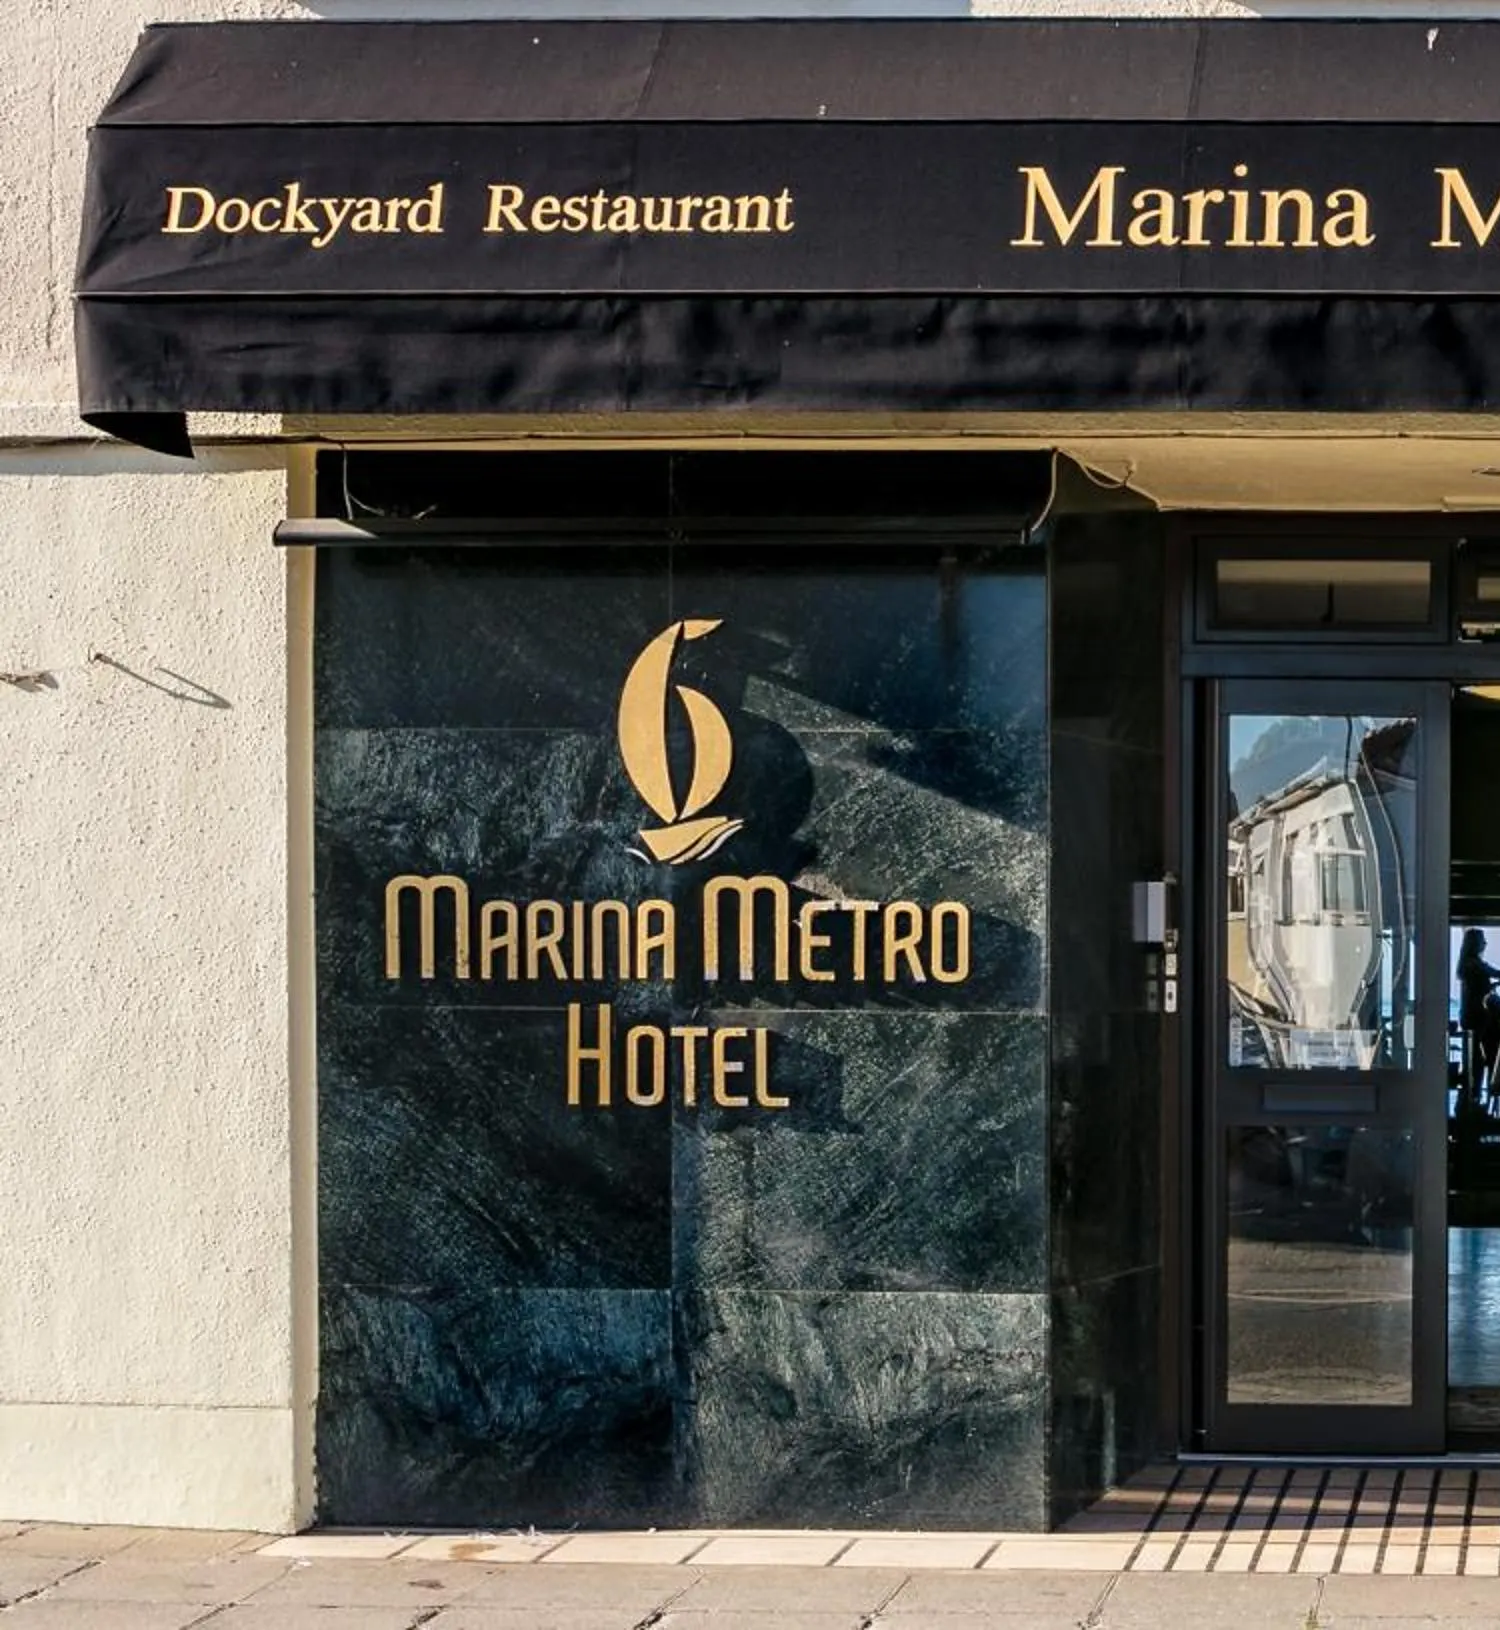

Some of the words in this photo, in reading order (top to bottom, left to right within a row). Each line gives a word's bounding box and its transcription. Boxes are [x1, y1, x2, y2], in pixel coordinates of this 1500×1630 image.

[162, 182, 444, 248] Dockyard
[483, 184, 793, 233] Restaurant
[1010, 164, 1375, 248] Marina
[385, 874, 676, 981] MARINA
[702, 875, 971, 984] METRO
[566, 1003, 790, 1108] HOTEL
